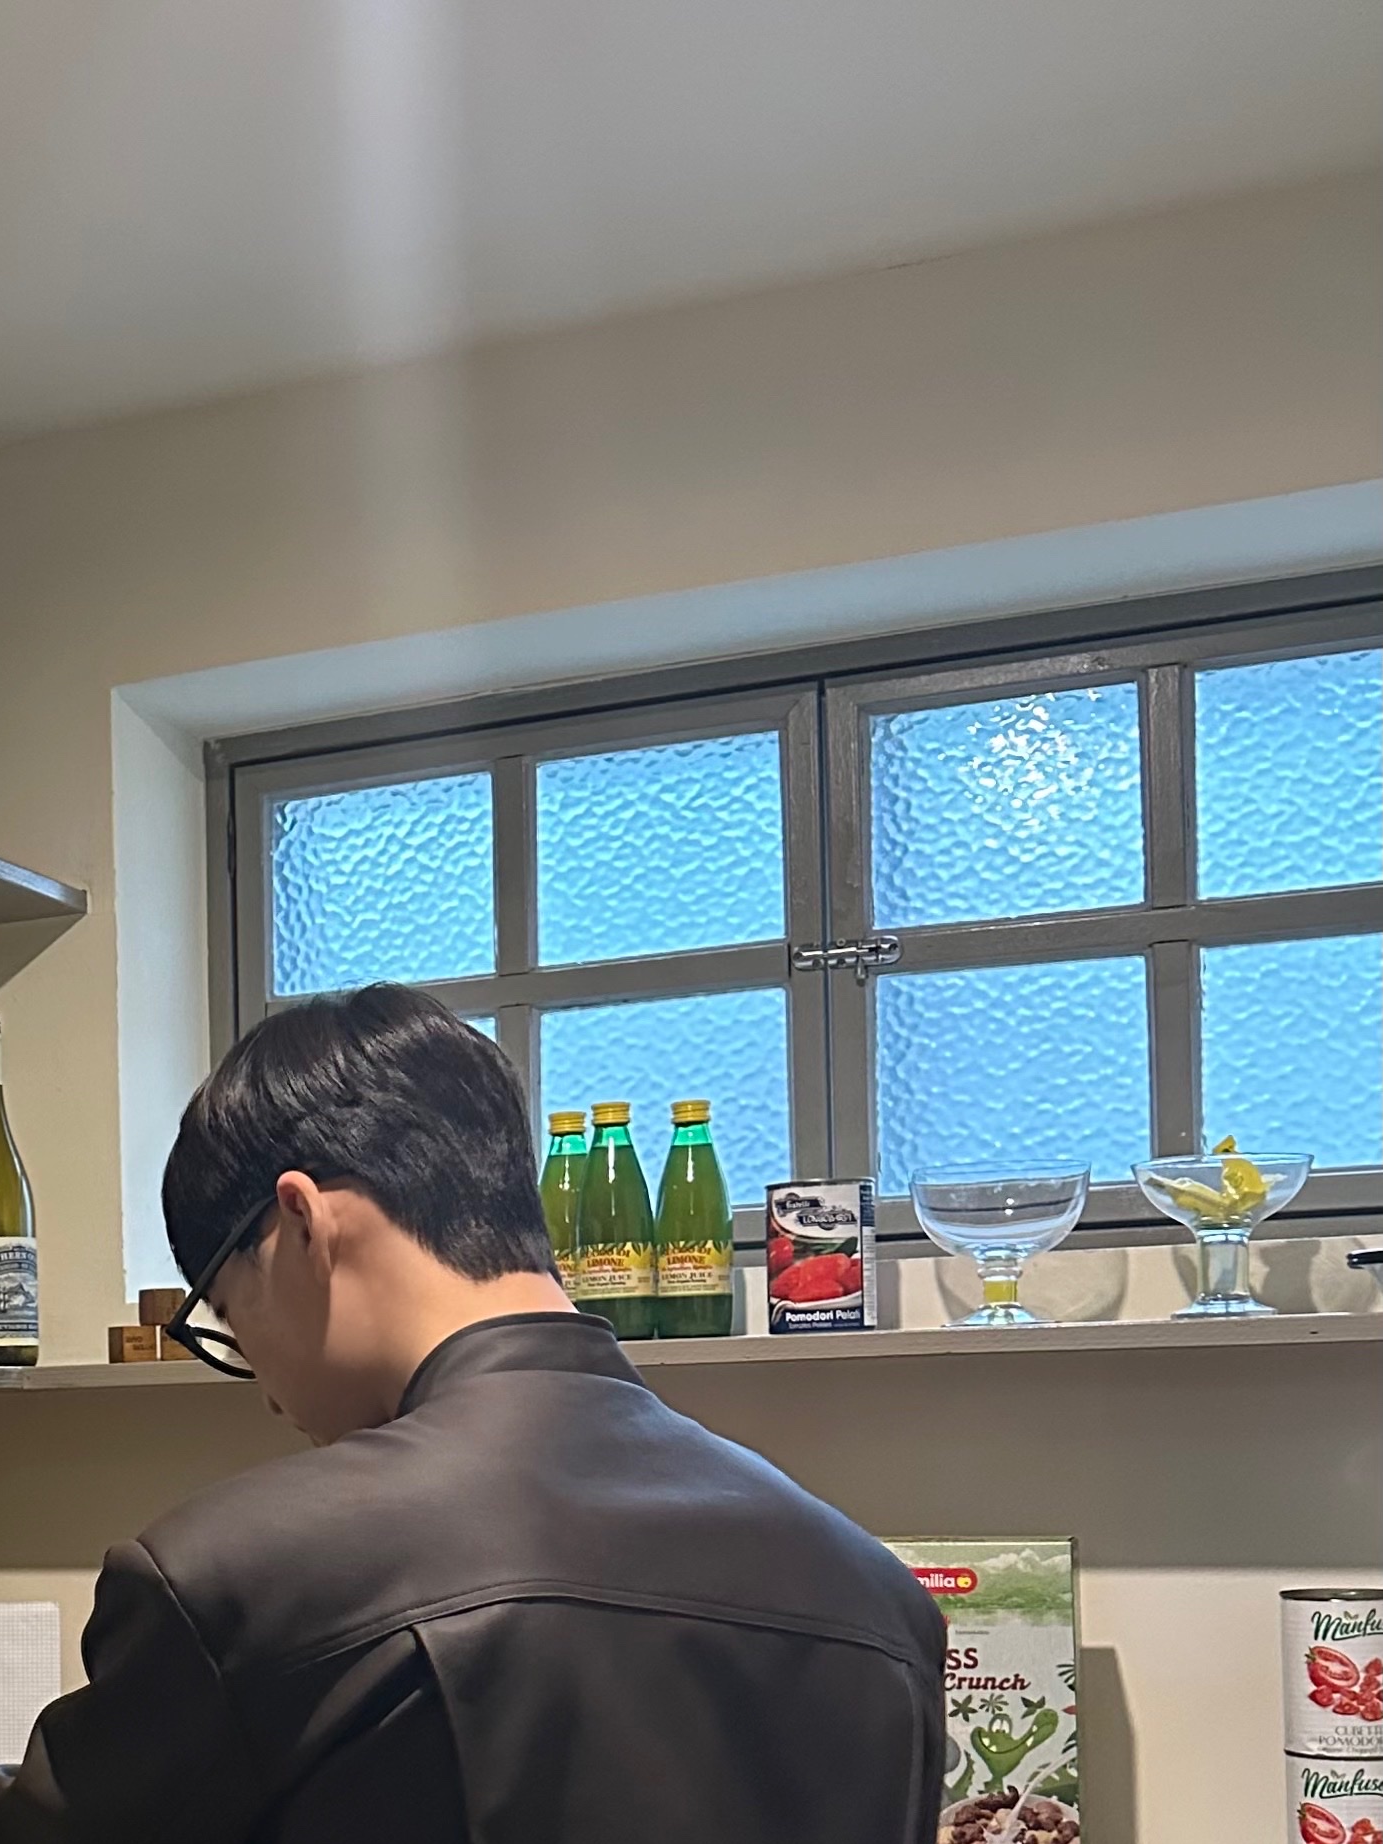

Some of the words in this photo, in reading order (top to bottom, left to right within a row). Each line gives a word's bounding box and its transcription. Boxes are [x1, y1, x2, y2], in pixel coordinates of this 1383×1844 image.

[586, 1258, 624, 1268] LIMONE
[666, 1255, 706, 1265] LIMONE
[785, 1311, 834, 1322] Pomodori
[917, 1573, 956, 1588] milia
[1311, 1608, 1383, 1641] Manfu
[943, 1672, 1032, 1691] Crunch
